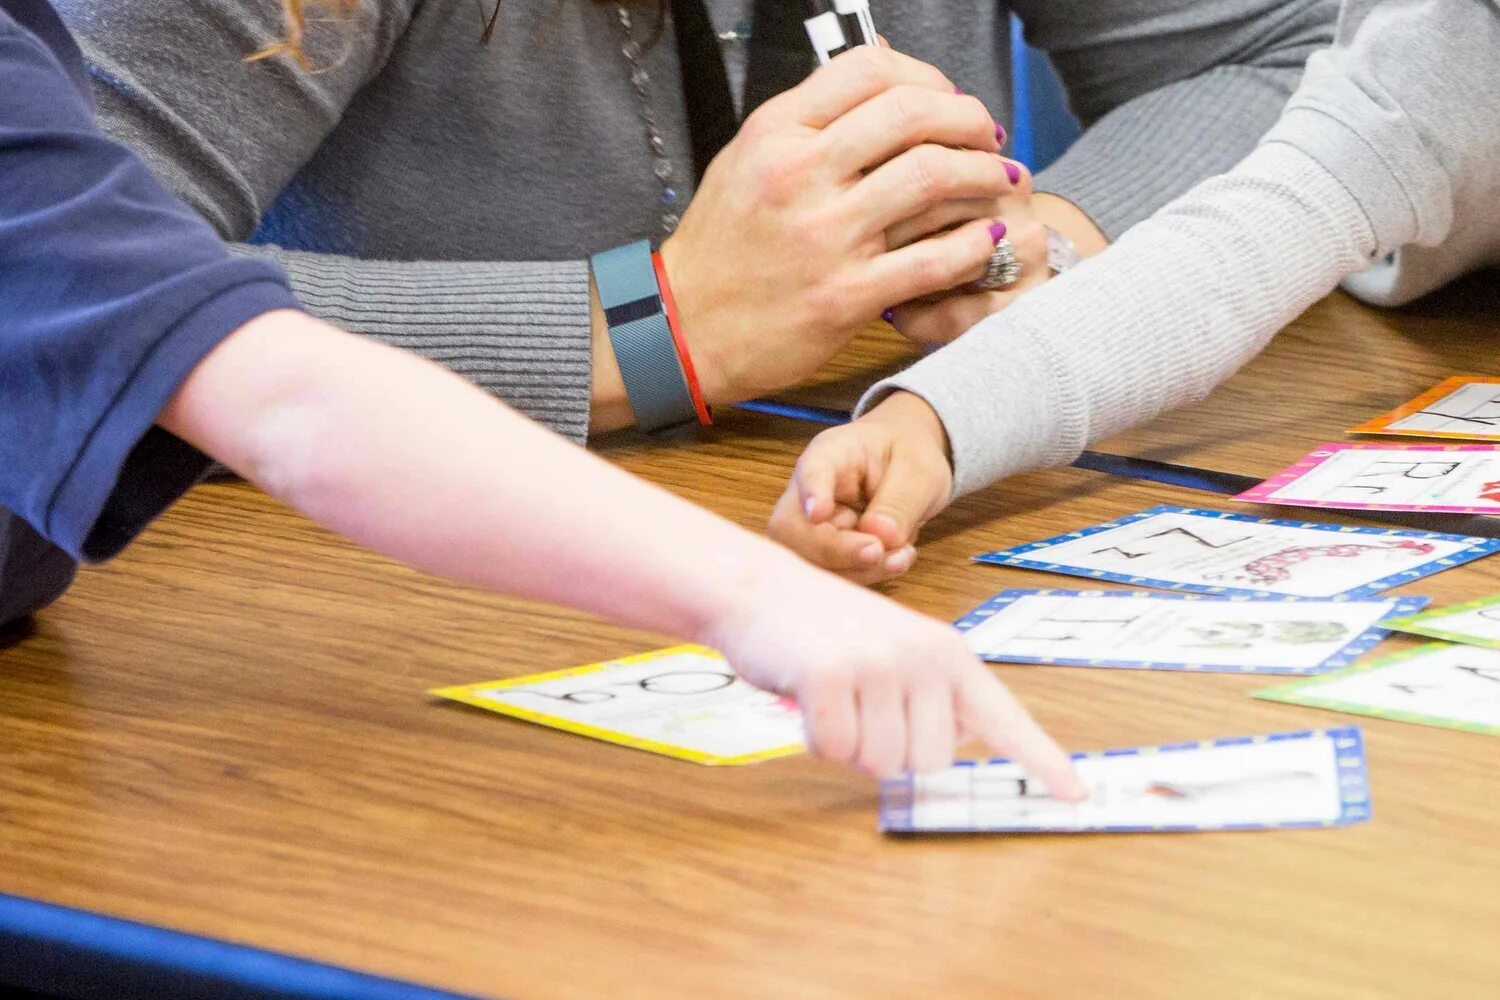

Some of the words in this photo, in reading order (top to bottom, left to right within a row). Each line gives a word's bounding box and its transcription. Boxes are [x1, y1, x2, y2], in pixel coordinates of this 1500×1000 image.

[1358, 461, 1460, 479] R
[1336, 485, 1387, 495] r
[1146, 528, 1253, 549] Z
[1090, 547, 1148, 558] z
[612, 672, 735, 695] Q
